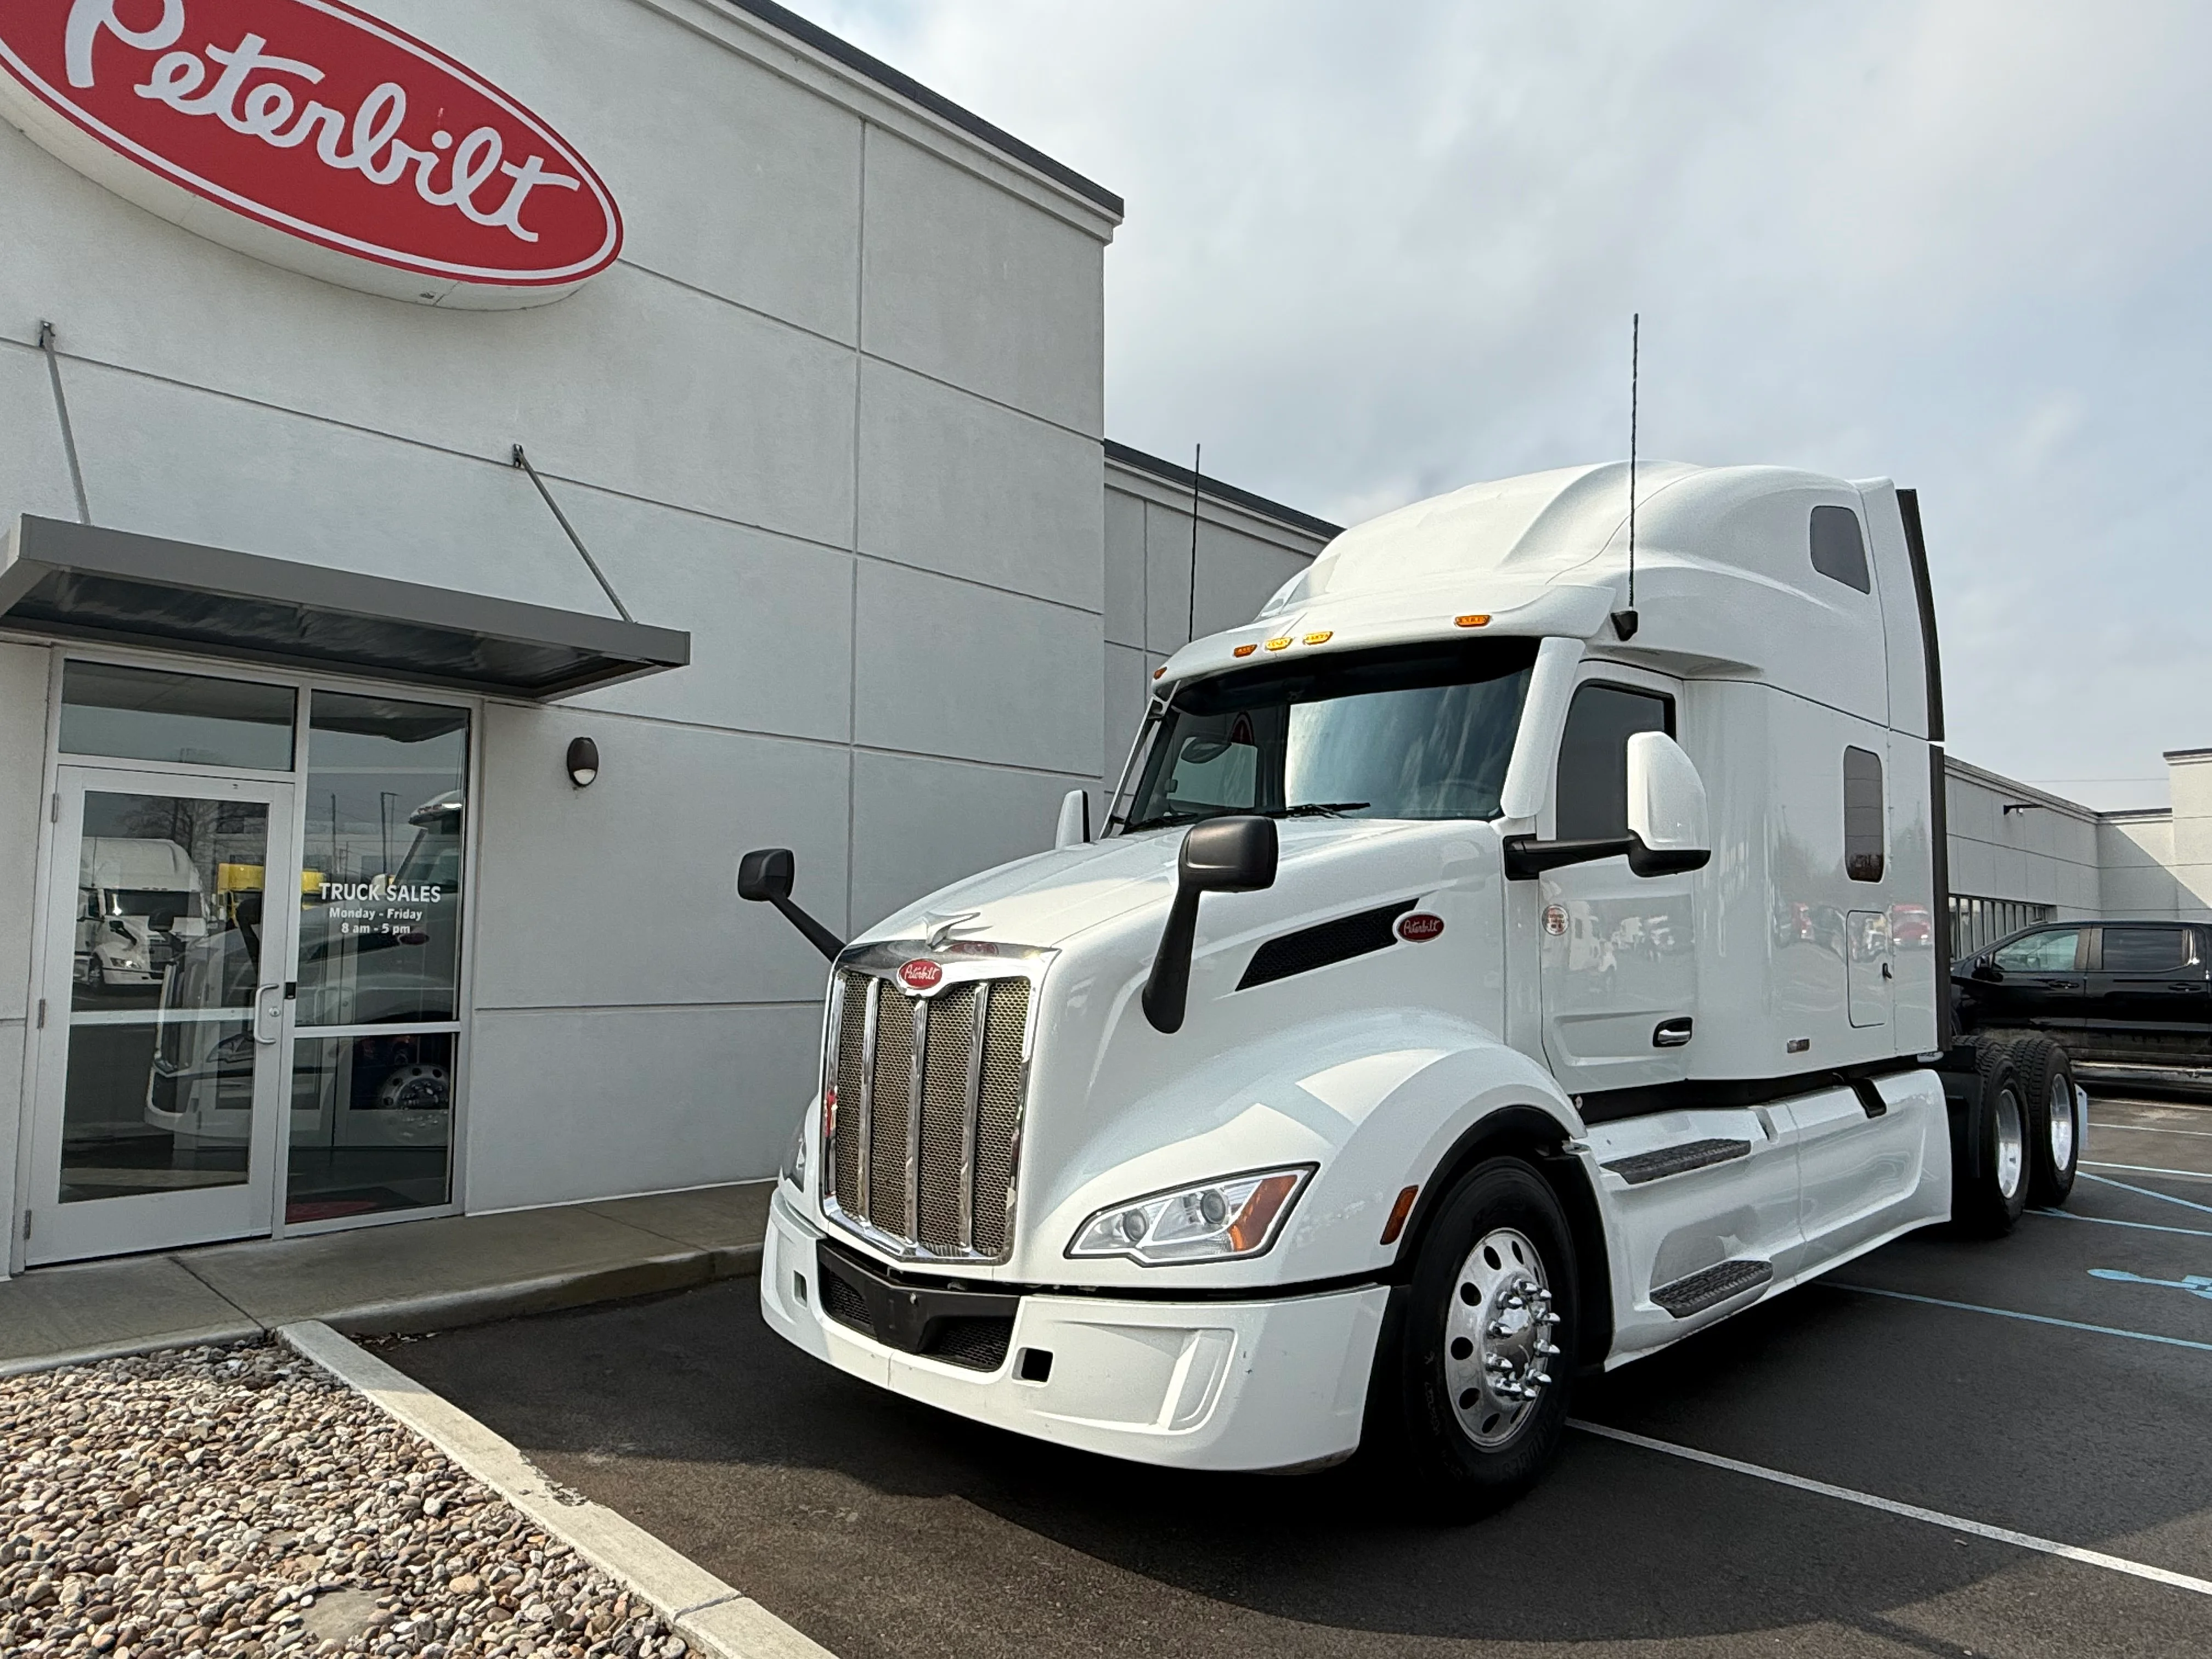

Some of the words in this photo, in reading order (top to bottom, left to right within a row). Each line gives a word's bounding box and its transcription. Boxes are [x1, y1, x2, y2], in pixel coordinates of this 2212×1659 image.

[65, 0, 580, 242] Peterbilt
[319, 883, 380, 901] TRUCK
[386, 885, 441, 903] SALES
[329, 907, 376, 921] Monday
[387, 909, 422, 921] Friday
[341, 922, 349, 933] 8
[353, 924, 370, 933] am
[381, 923, 390, 934] 5
[393, 925, 410, 935] pm
[904, 963, 940, 980] Peterbilt
